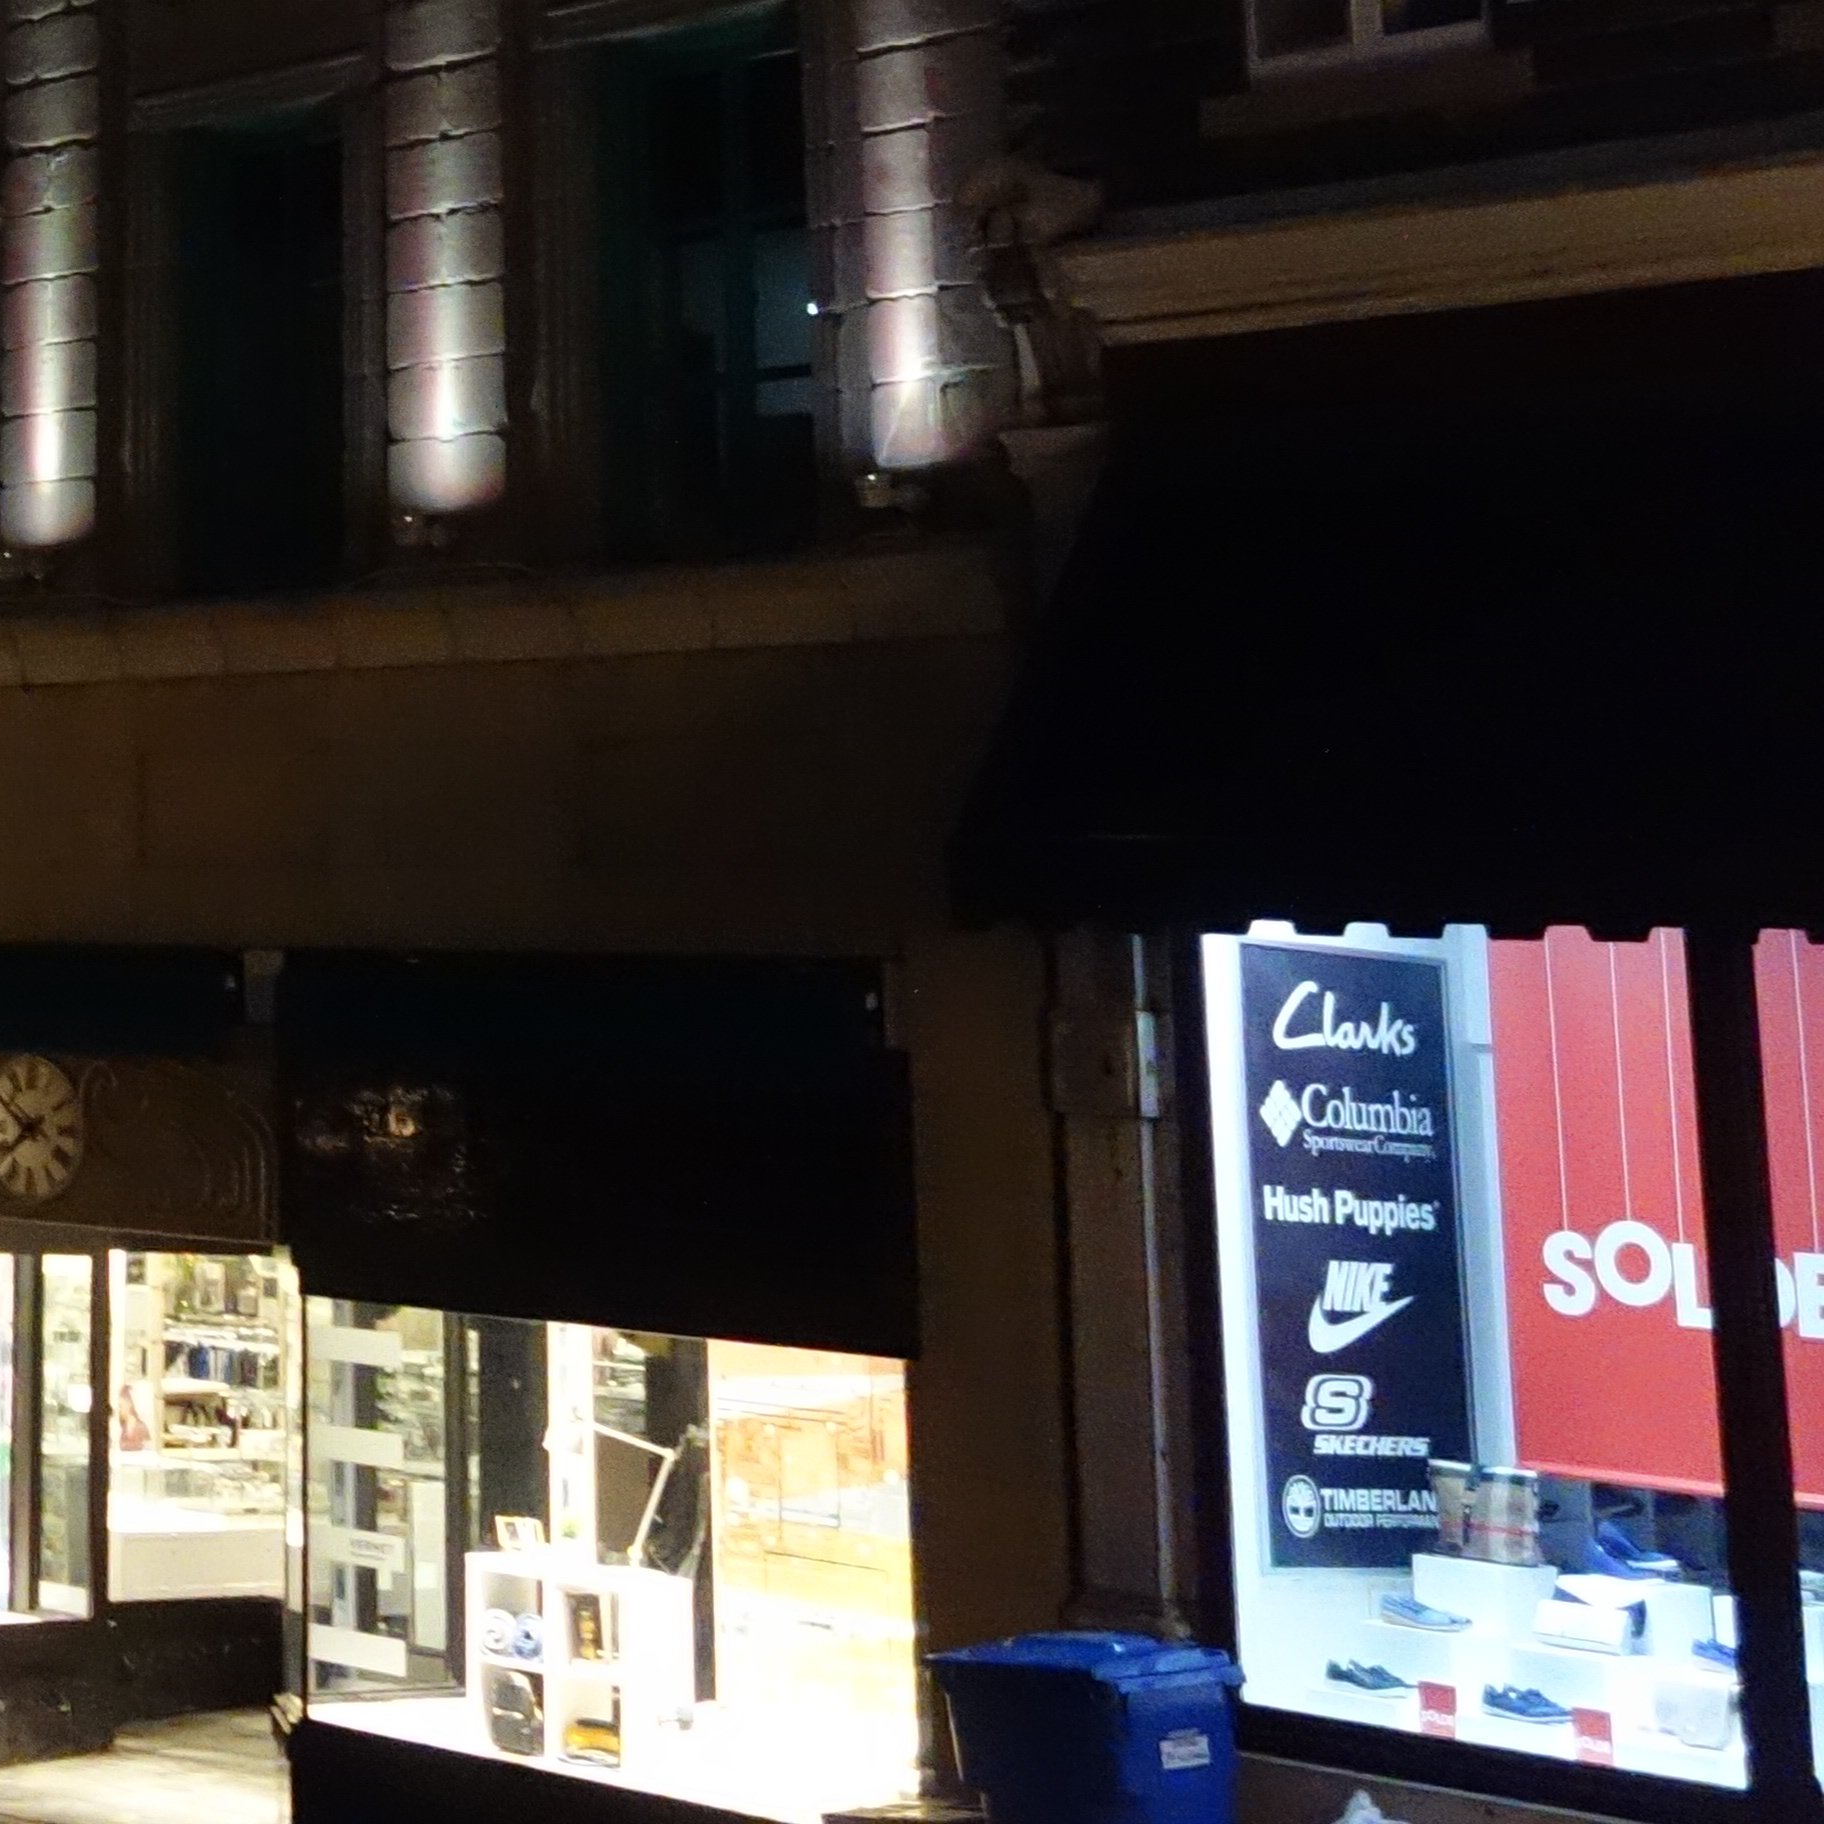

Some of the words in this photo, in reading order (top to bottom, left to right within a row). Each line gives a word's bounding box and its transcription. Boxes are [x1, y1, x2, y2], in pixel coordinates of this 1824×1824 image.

[1272, 980, 1417, 1056] Clarks
[1301, 1083, 1434, 1137] Columbia
[1263, 1184, 1330, 1224] Hush
[1333, 1189, 1437, 1236] Puppies
[1322, 1260, 1395, 1313] NIKE
[1542, 1220, 1824, 1340] SOLE
[1313, 1434, 1431, 1457] SKECHERS
[1320, 1488, 1438, 1512] TIMBERLAN
